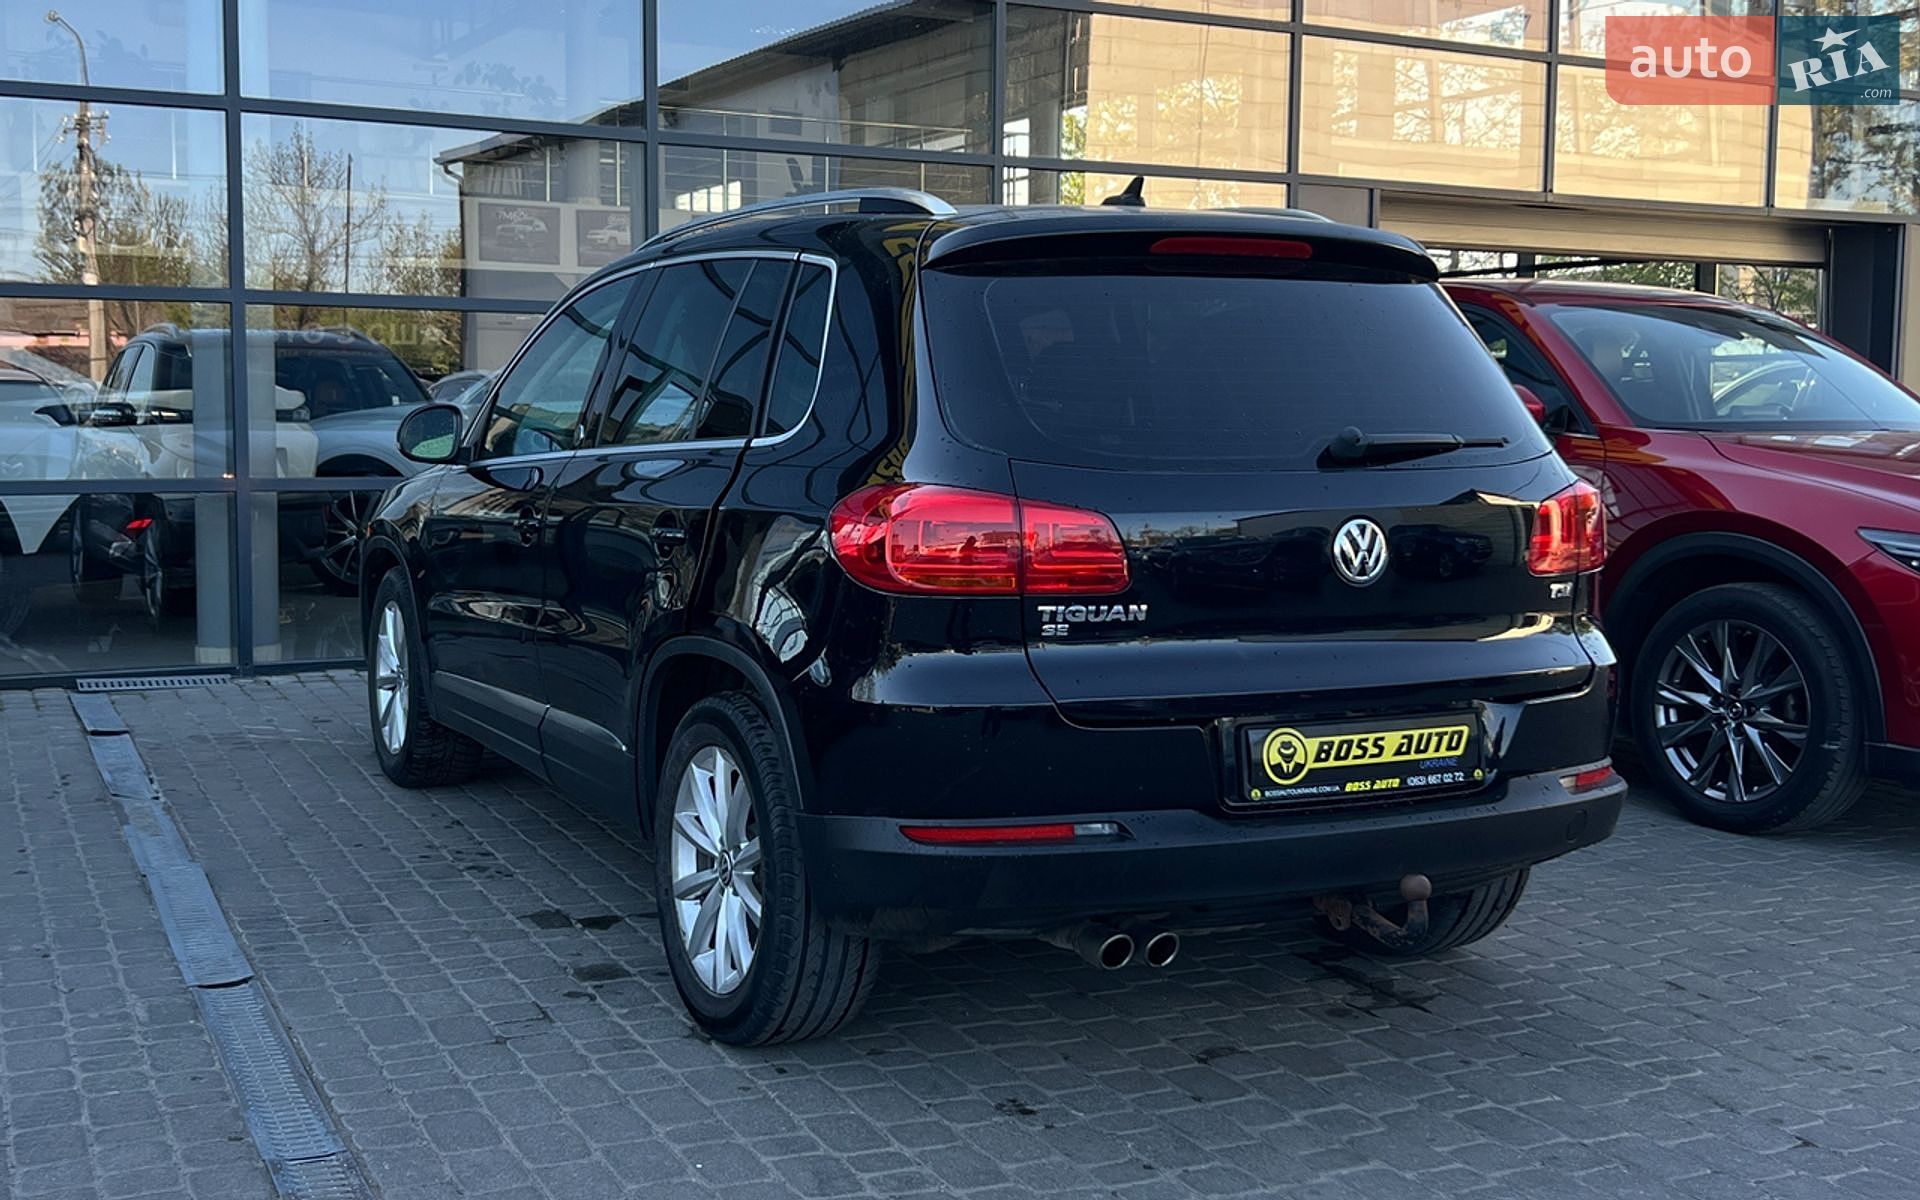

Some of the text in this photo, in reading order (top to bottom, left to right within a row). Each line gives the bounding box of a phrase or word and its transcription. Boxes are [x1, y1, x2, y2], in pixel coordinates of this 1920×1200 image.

[1037, 604, 1148, 622] TIGUAN
[1041, 624, 1069, 636] SE
[1313, 729, 1465, 763] BOSS AUTO
[1419, 756, 1458, 769] UKRAINE
[1453, 771, 1465, 782] 72
[1344, 778, 1401, 792] BOSS AUTO
